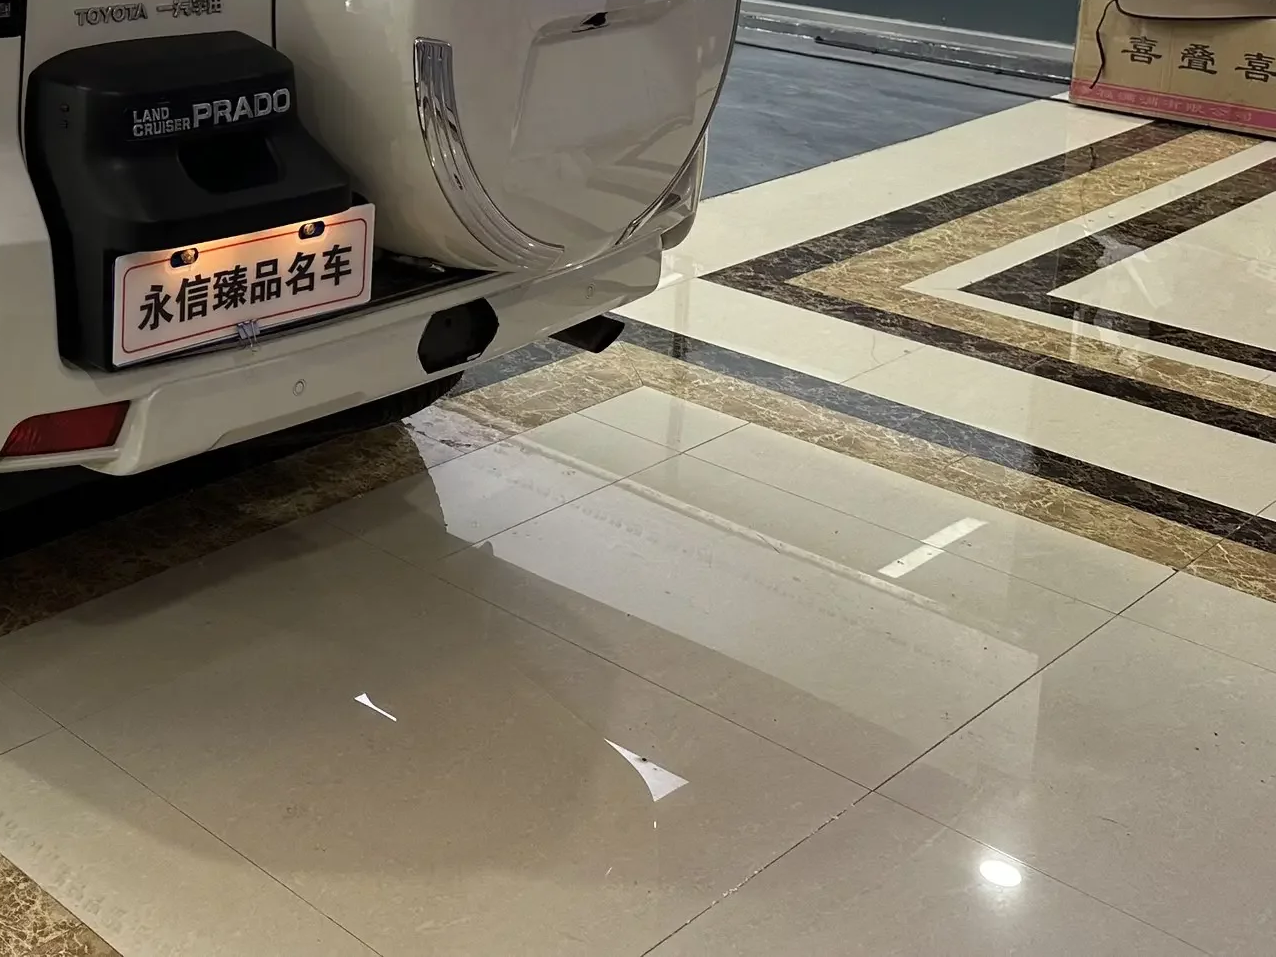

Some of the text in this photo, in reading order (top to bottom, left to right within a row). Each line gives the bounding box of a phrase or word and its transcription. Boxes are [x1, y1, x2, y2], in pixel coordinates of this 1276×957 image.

[74, 2, 148, 26] TOYOTA
[133, 107, 170, 124] LAND
[192, 88, 291, 128] PRADO
[132, 117, 191, 137] CRUISER
[138, 244, 352, 330] 永信臻品名车
